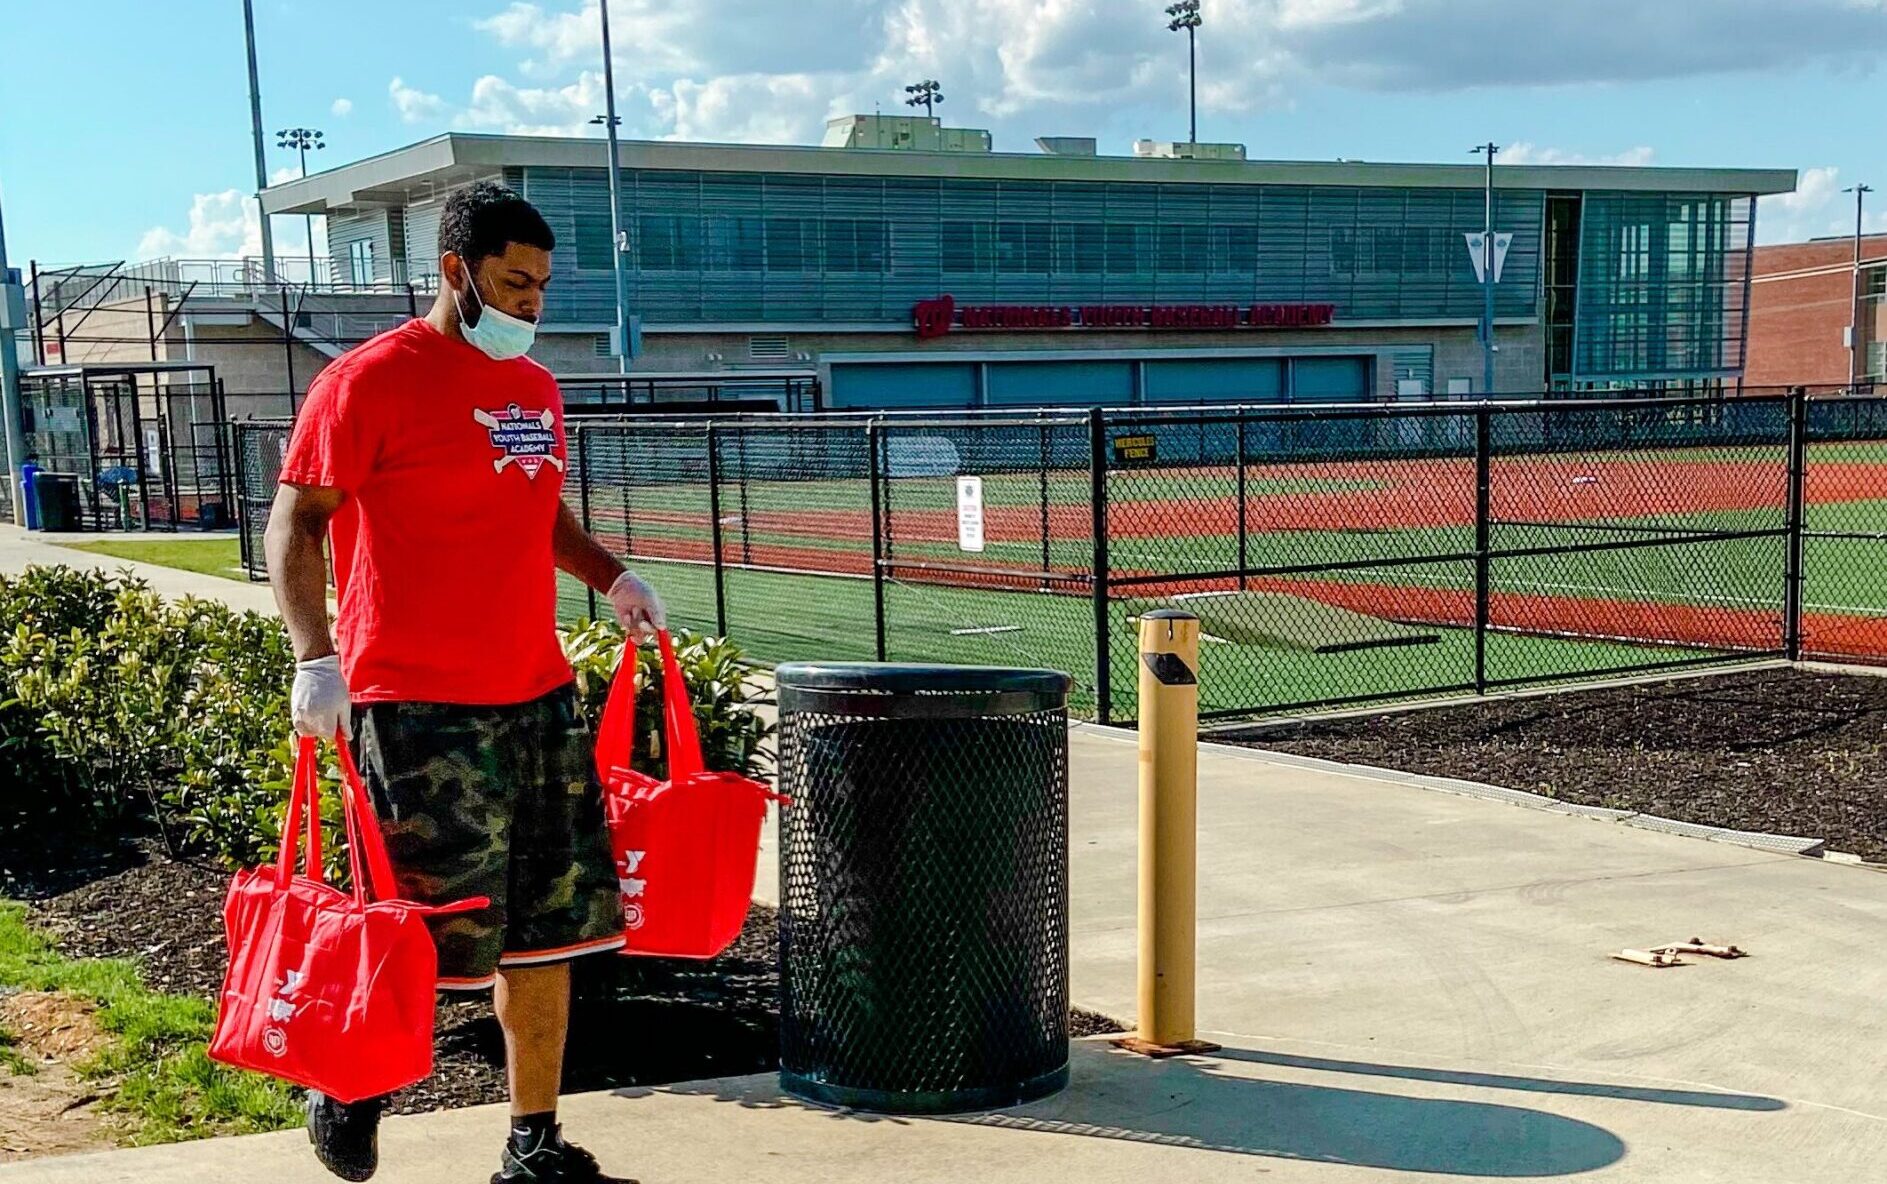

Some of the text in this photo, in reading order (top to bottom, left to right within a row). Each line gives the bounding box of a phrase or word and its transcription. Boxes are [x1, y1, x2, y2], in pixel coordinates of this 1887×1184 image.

[1152, 306, 1239, 327] BASEBALL
[1250, 305, 1334, 326] ACADEMY
[500, 422, 541, 430] NATIONALS
[493, 433, 554, 442] YOUTH BASEBALL
[511, 444, 545, 453] ACADEMY
